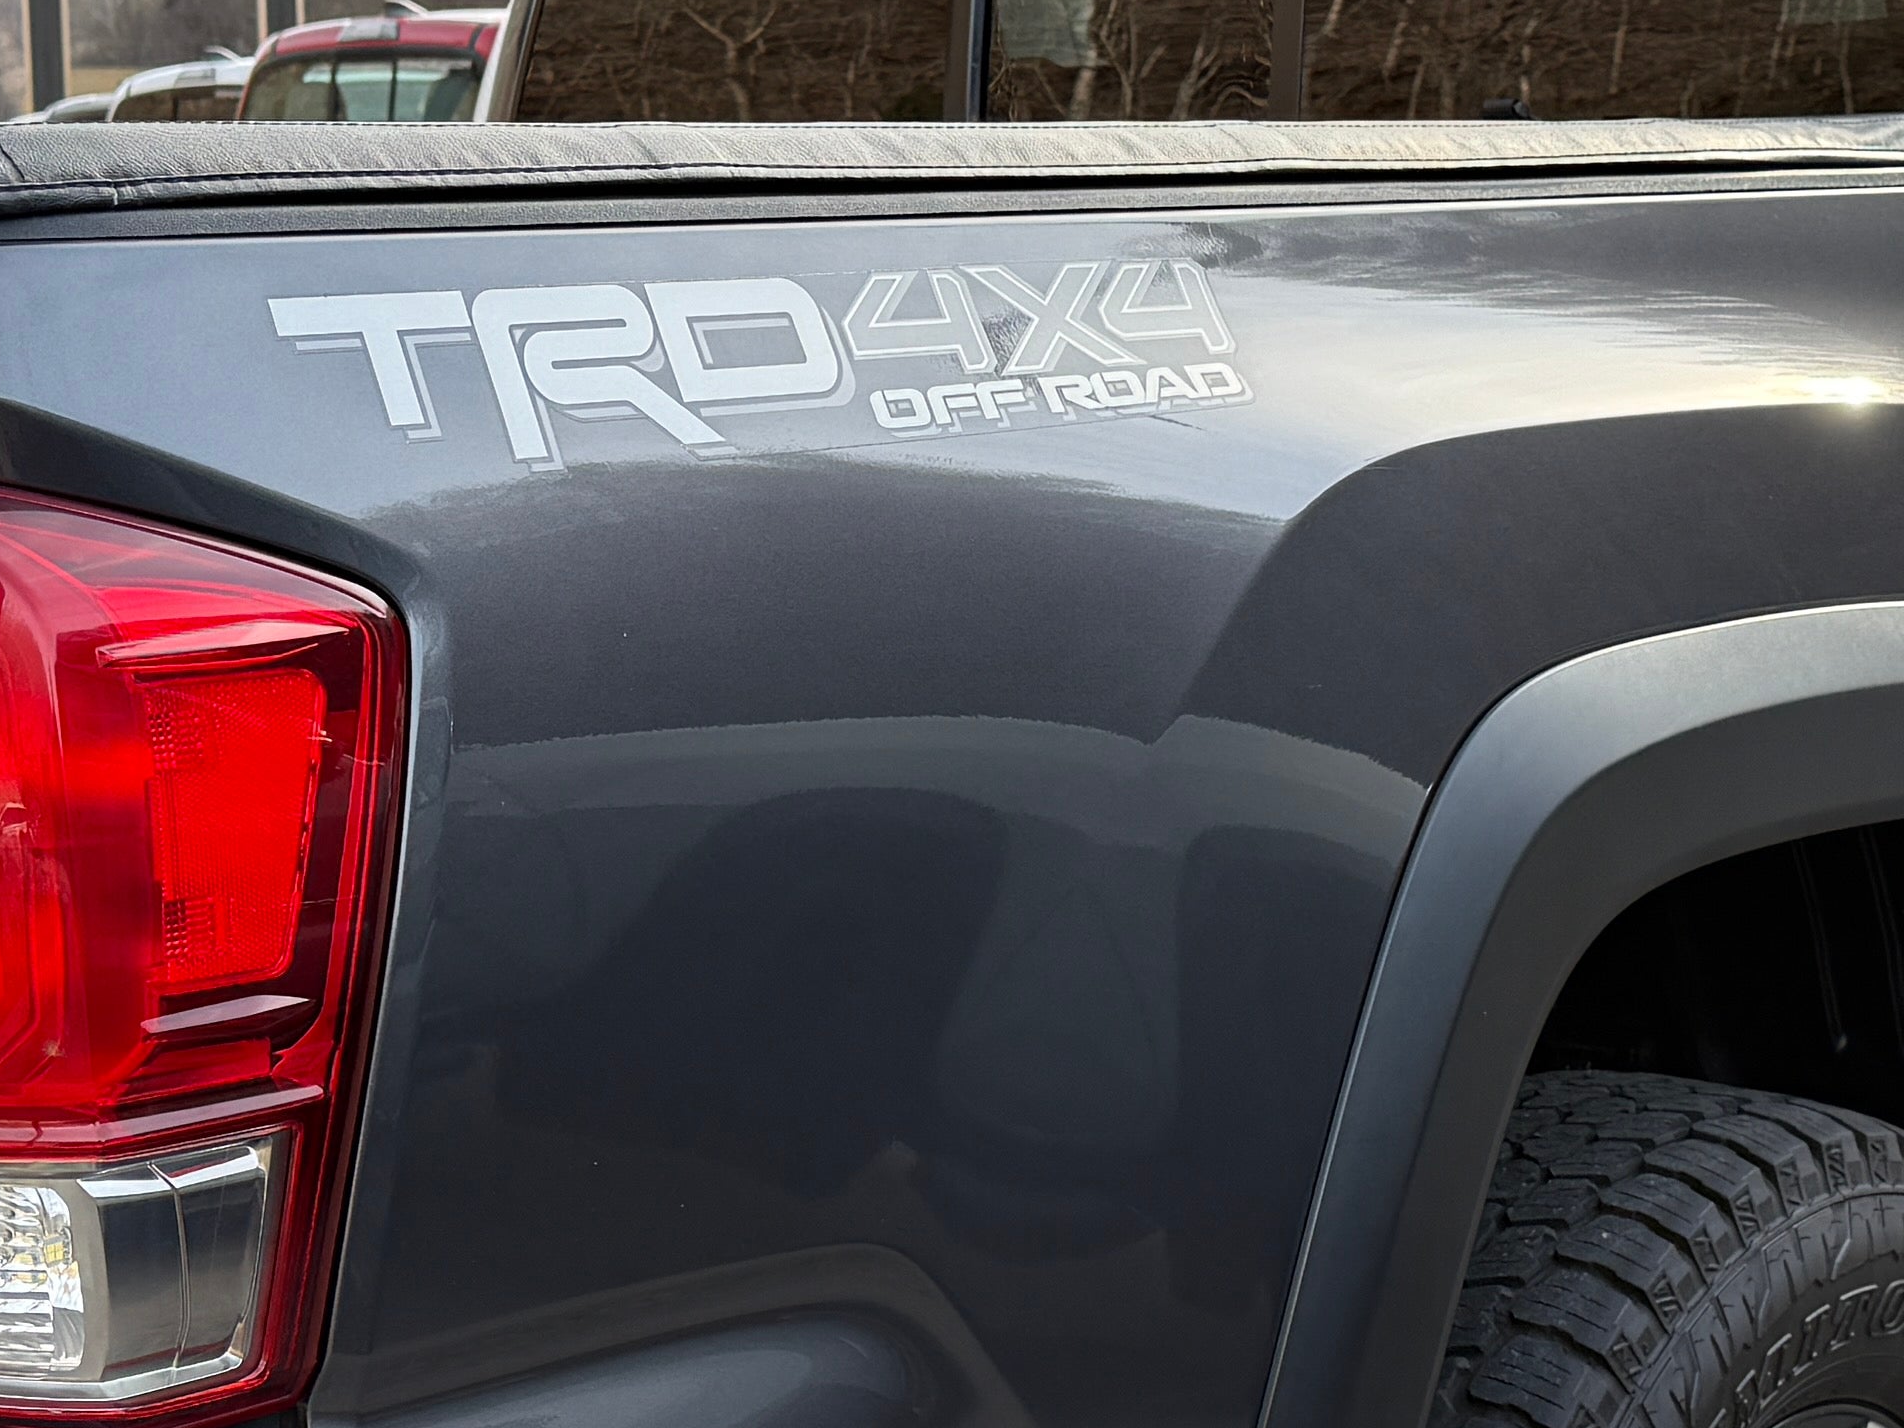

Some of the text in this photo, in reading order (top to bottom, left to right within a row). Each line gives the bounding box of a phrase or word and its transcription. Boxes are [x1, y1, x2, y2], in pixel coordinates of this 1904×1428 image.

[267, 256, 1239, 473] TRD 4X4
[869, 361, 1254, 438] OFF ROAD
